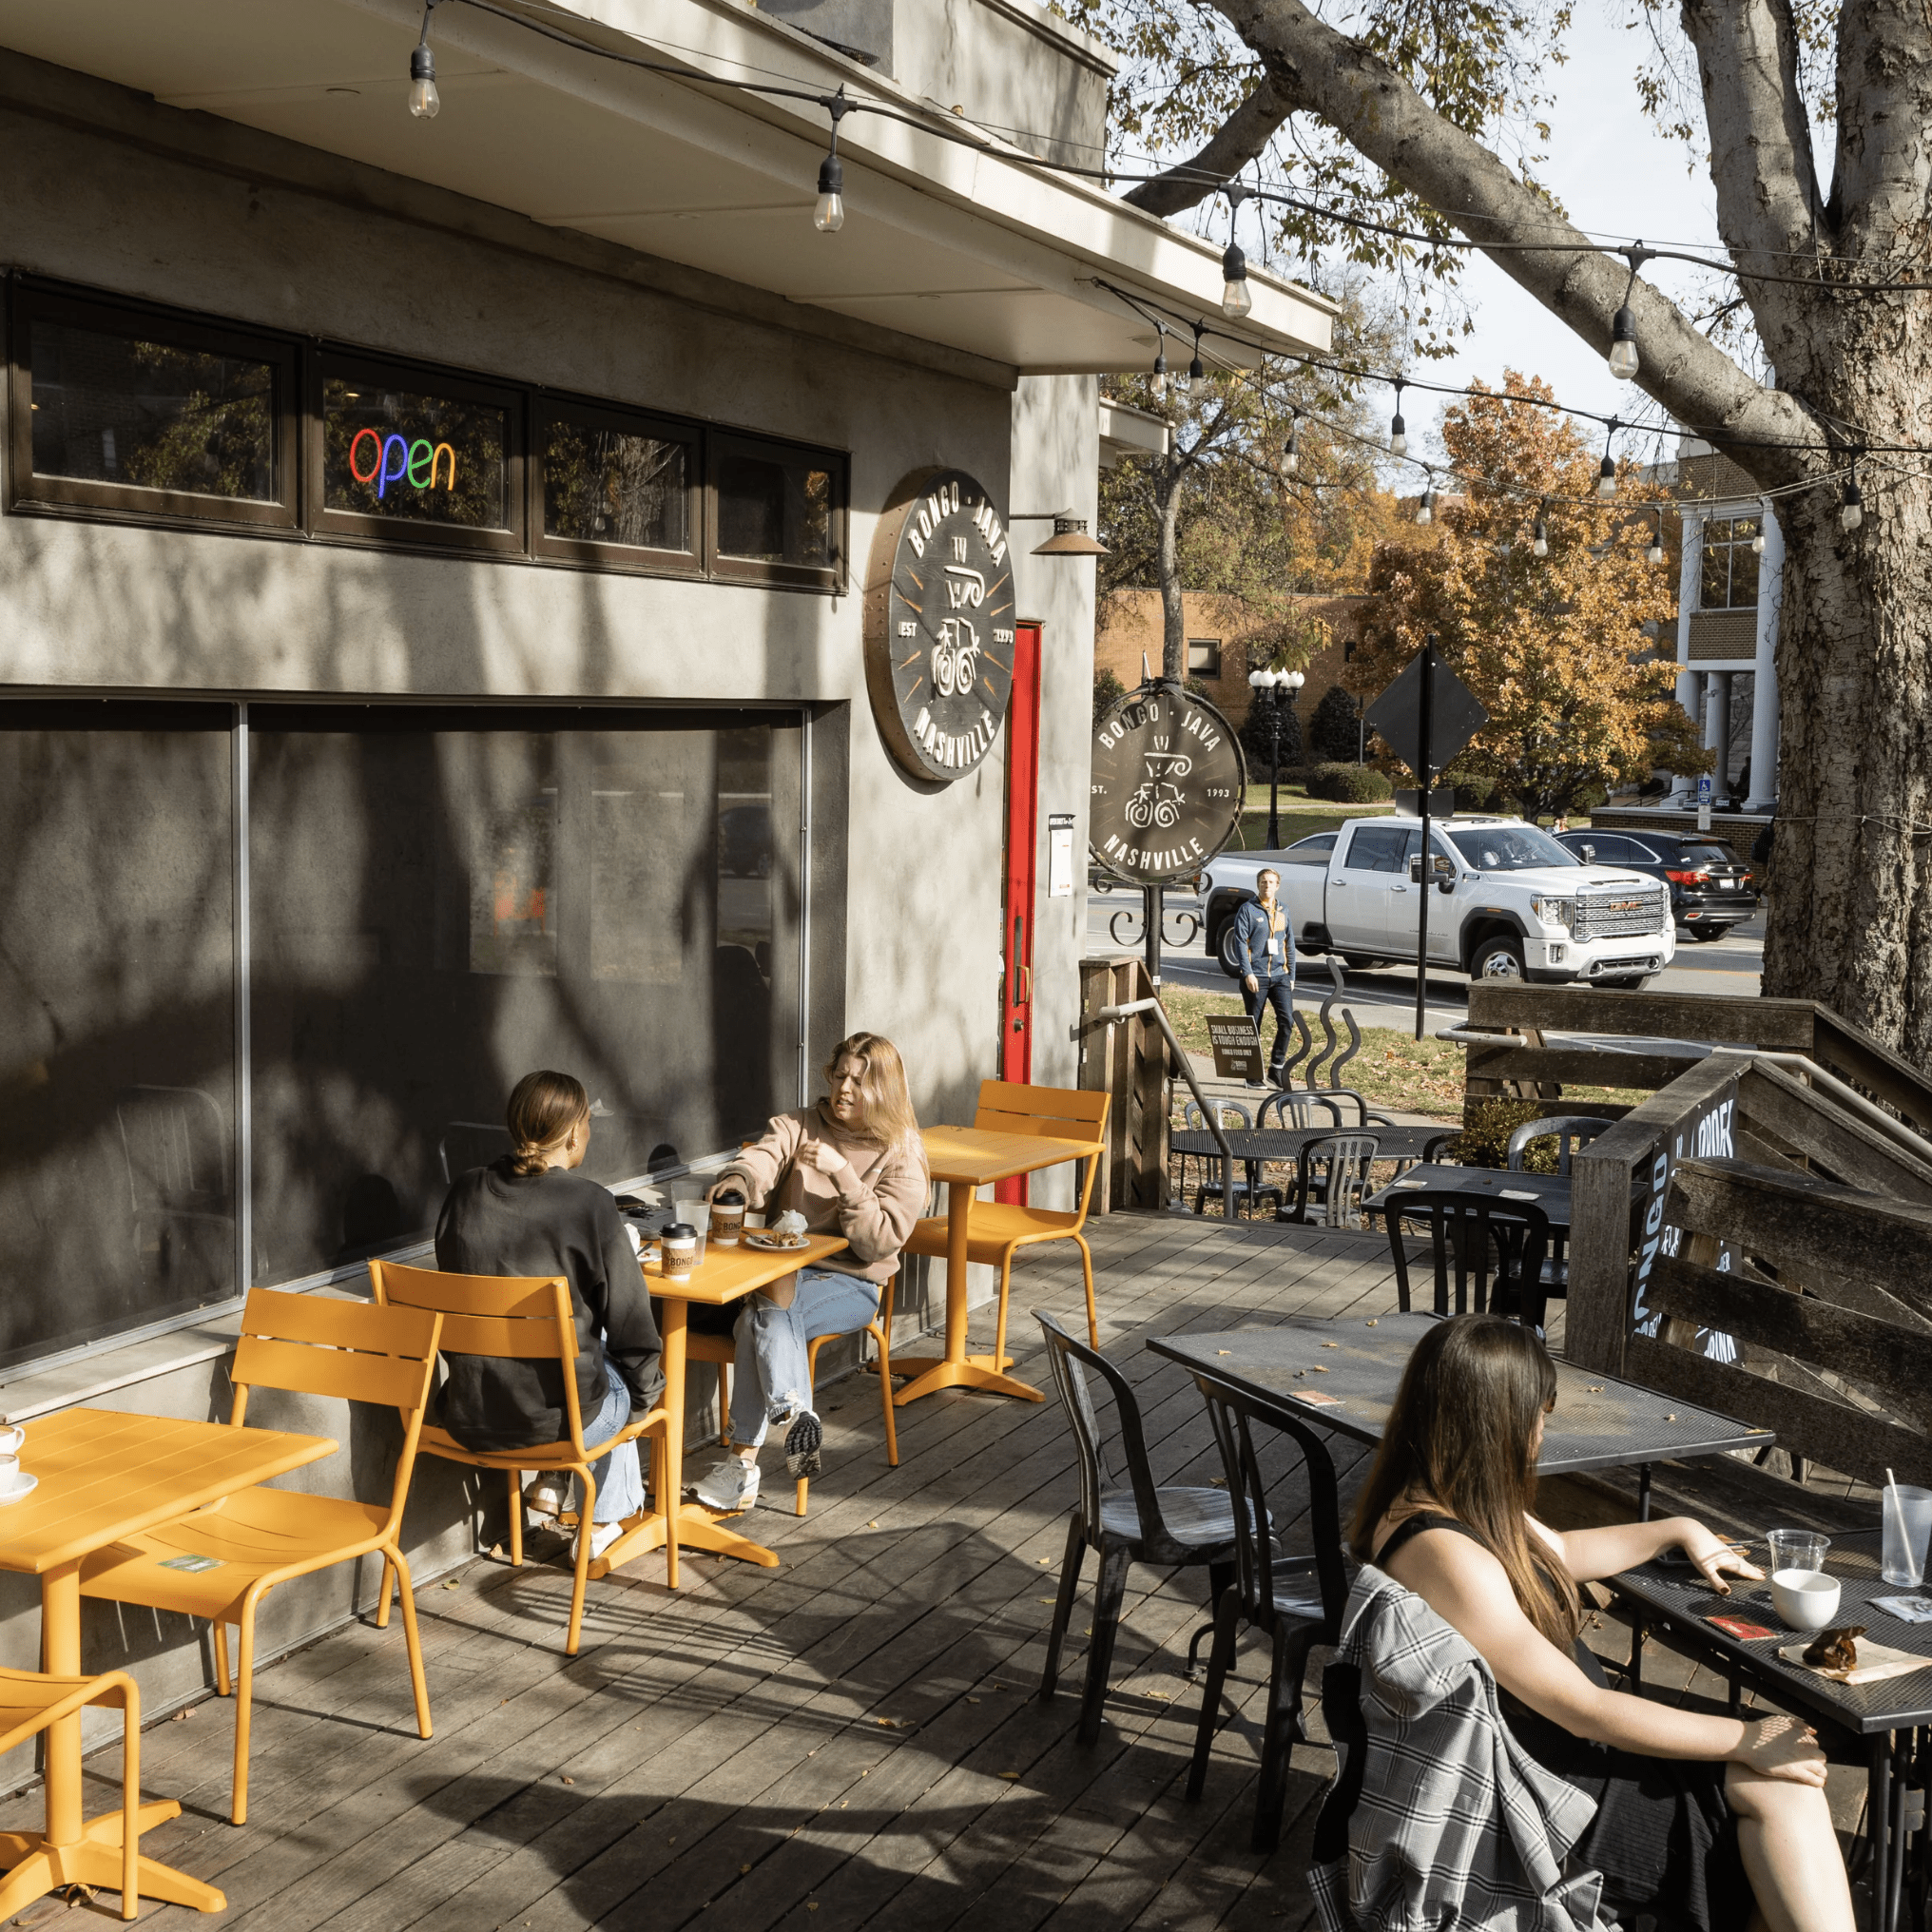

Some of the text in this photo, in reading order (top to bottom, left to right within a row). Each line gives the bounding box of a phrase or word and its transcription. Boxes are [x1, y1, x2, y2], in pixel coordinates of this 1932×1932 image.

[907, 480, 1006, 568] BONGO JAVA
[898, 621, 917, 636] EST
[994, 628, 1014, 644] 1993
[1098, 703, 1221, 752] BONGO JAVA
[914, 707, 995, 768] NASHVILLE
[1091, 784, 1108, 795] ST.
[1207, 788, 1229, 798] 1993
[1103, 833, 1204, 870] NASHVILLE
[1211, 1025, 1254, 1035] SMALL BUSINESS
[1236, 1036, 1258, 1046] ENOUGH
